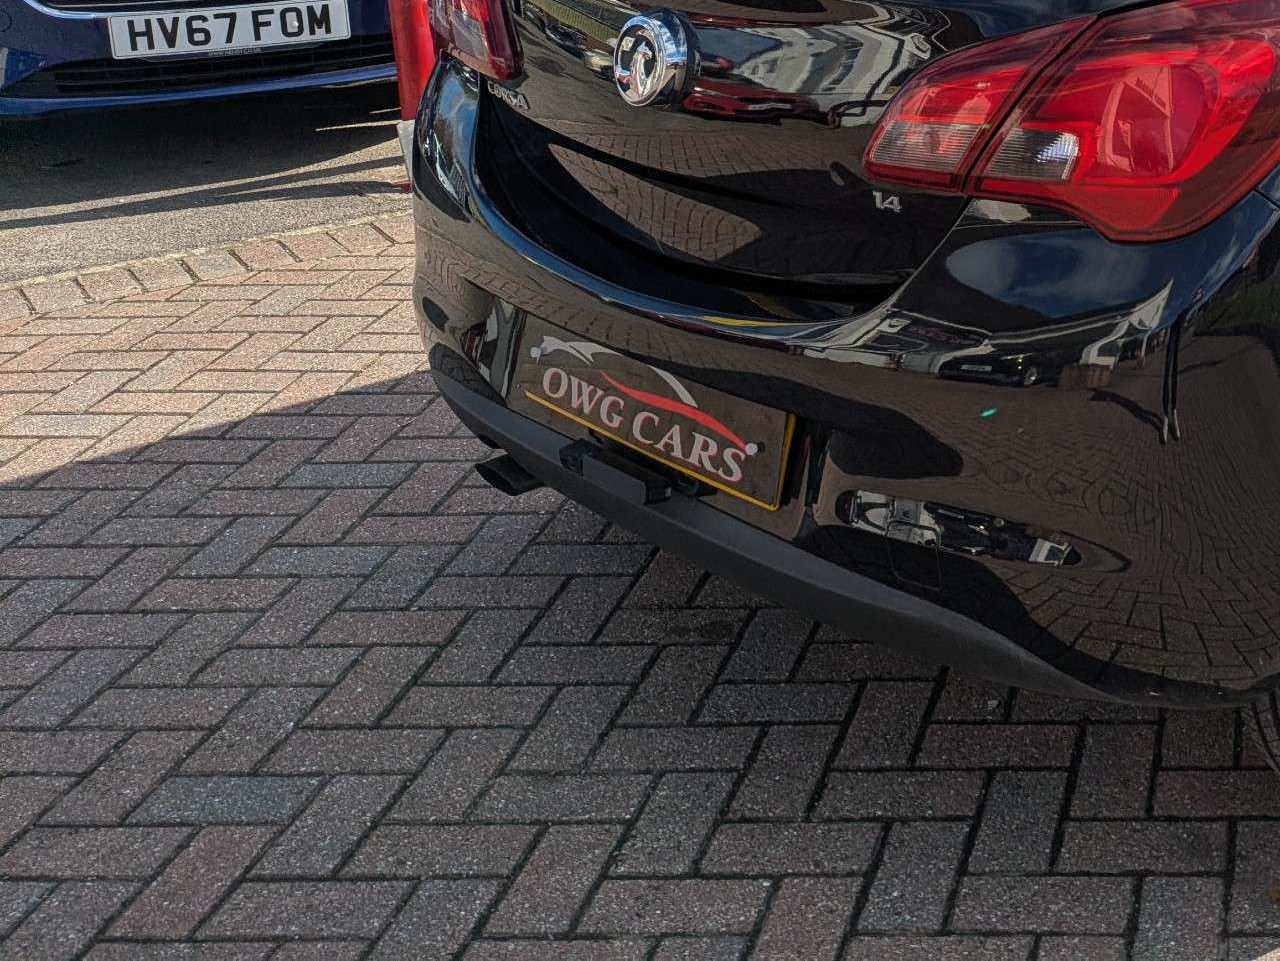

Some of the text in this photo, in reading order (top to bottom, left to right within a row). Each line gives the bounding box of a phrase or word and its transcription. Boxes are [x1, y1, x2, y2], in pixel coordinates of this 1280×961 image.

[127, 3, 332, 51] HV67 FOM
[487, 80, 530, 110] CORSA
[541, 367, 747, 482] OWG CARS
